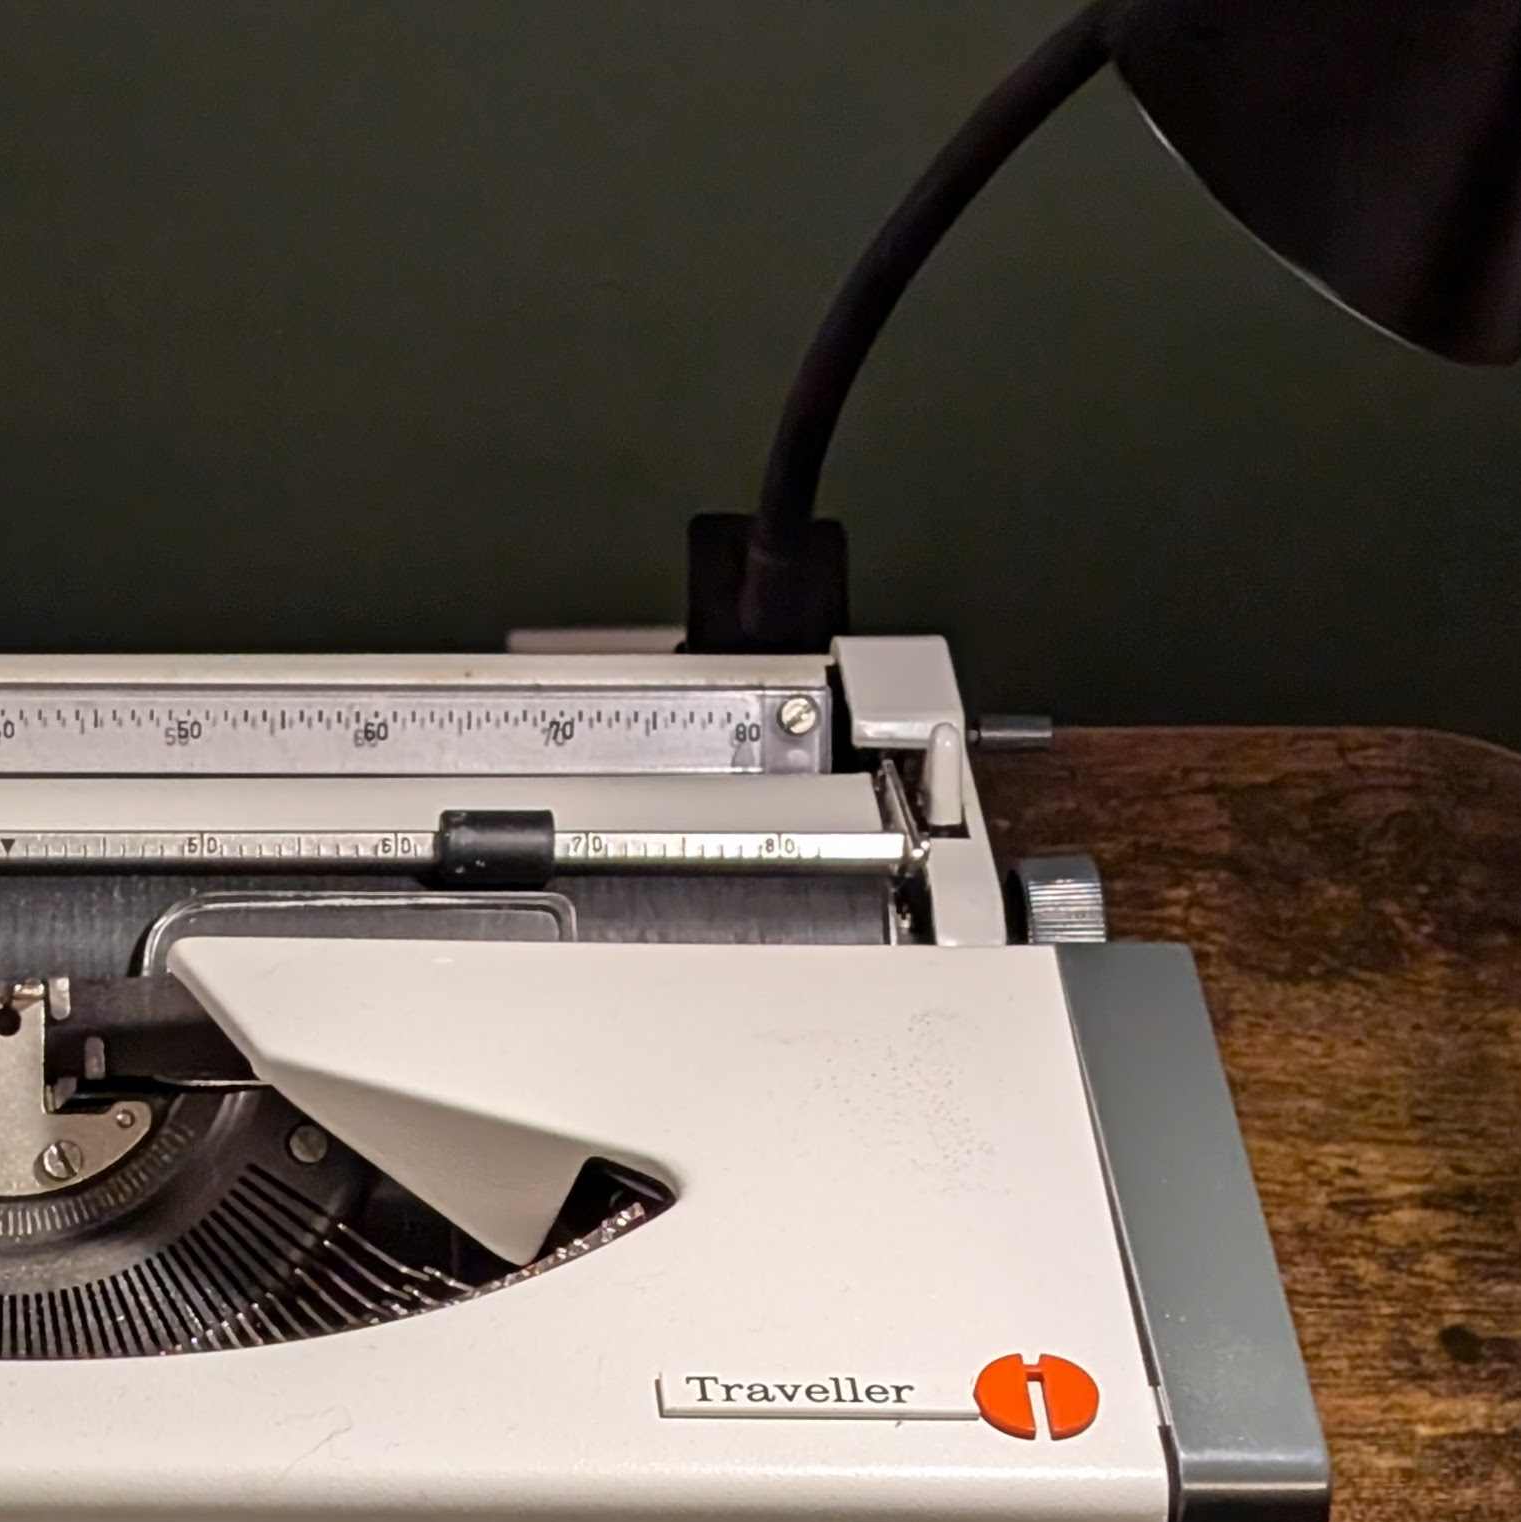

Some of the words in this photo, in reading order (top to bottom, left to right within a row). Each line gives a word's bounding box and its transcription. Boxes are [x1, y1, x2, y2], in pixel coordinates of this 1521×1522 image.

[177, 722, 203, 740] 50
[363, 722, 390, 742] 60
[550, 721, 575, 741] 70
[735, 723, 761, 743] 80
[685, 1376, 915, 1404] Traveller
